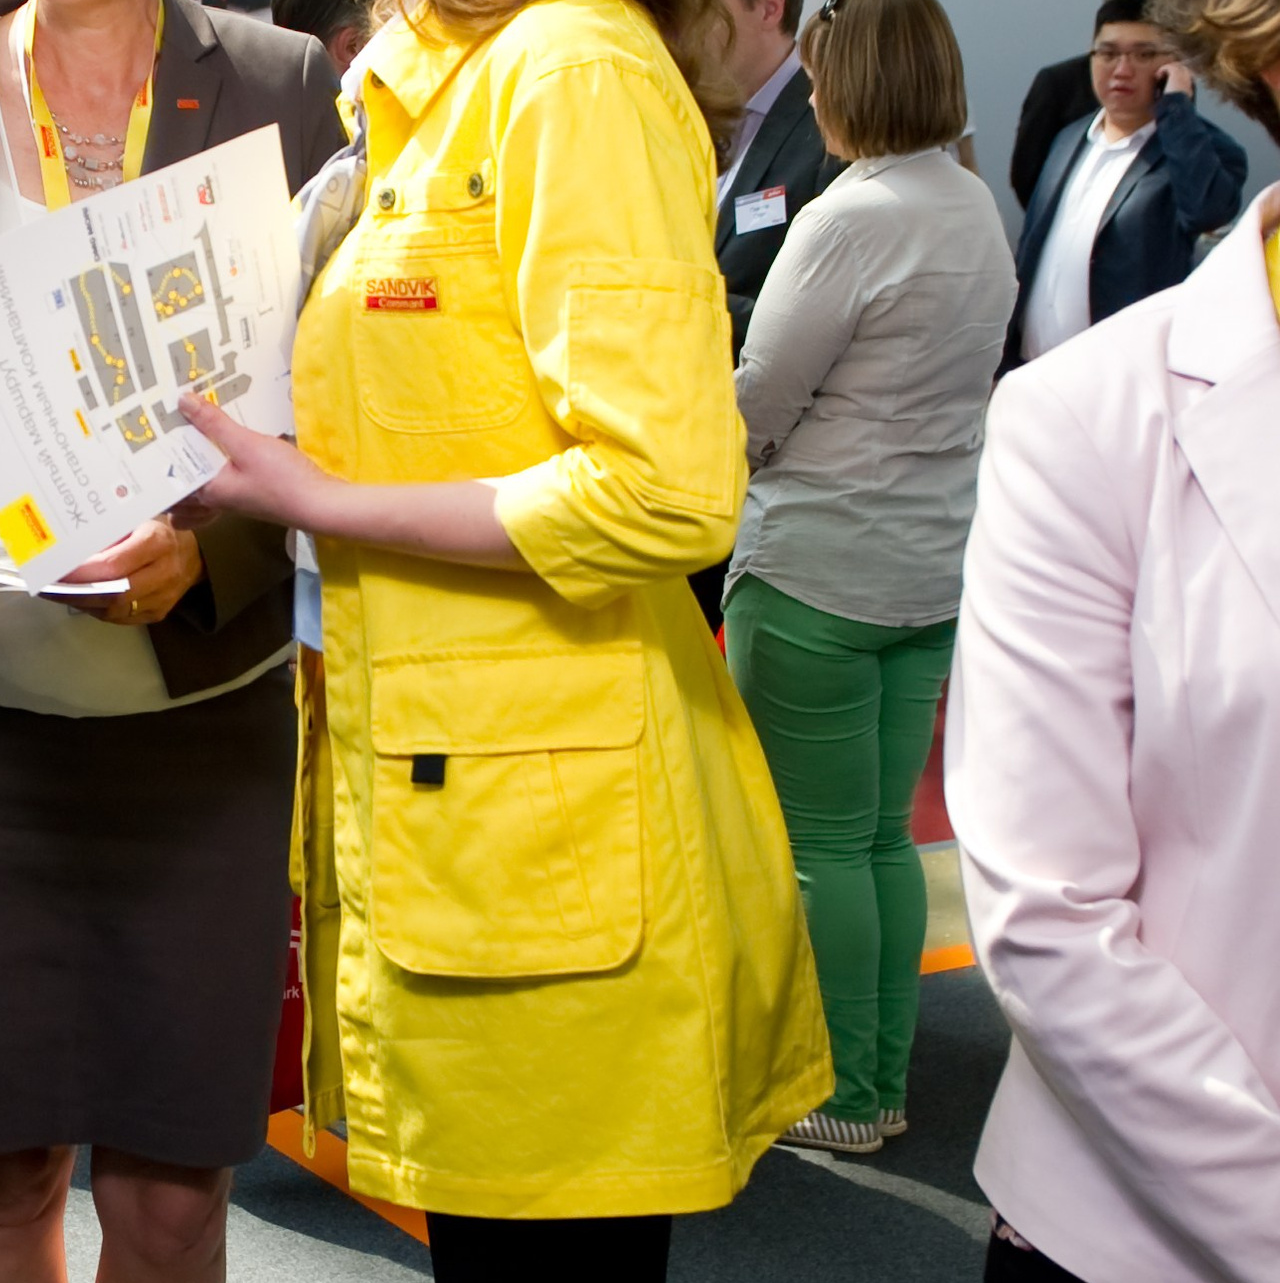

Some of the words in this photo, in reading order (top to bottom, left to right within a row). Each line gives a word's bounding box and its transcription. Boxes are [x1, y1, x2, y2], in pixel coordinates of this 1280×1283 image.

[366, 277, 435, 295] SANDVIK
[32, 381, 90, 487] станочным
[38, 448, 88, 530] Желтый
[87, 490, 106, 515] по
